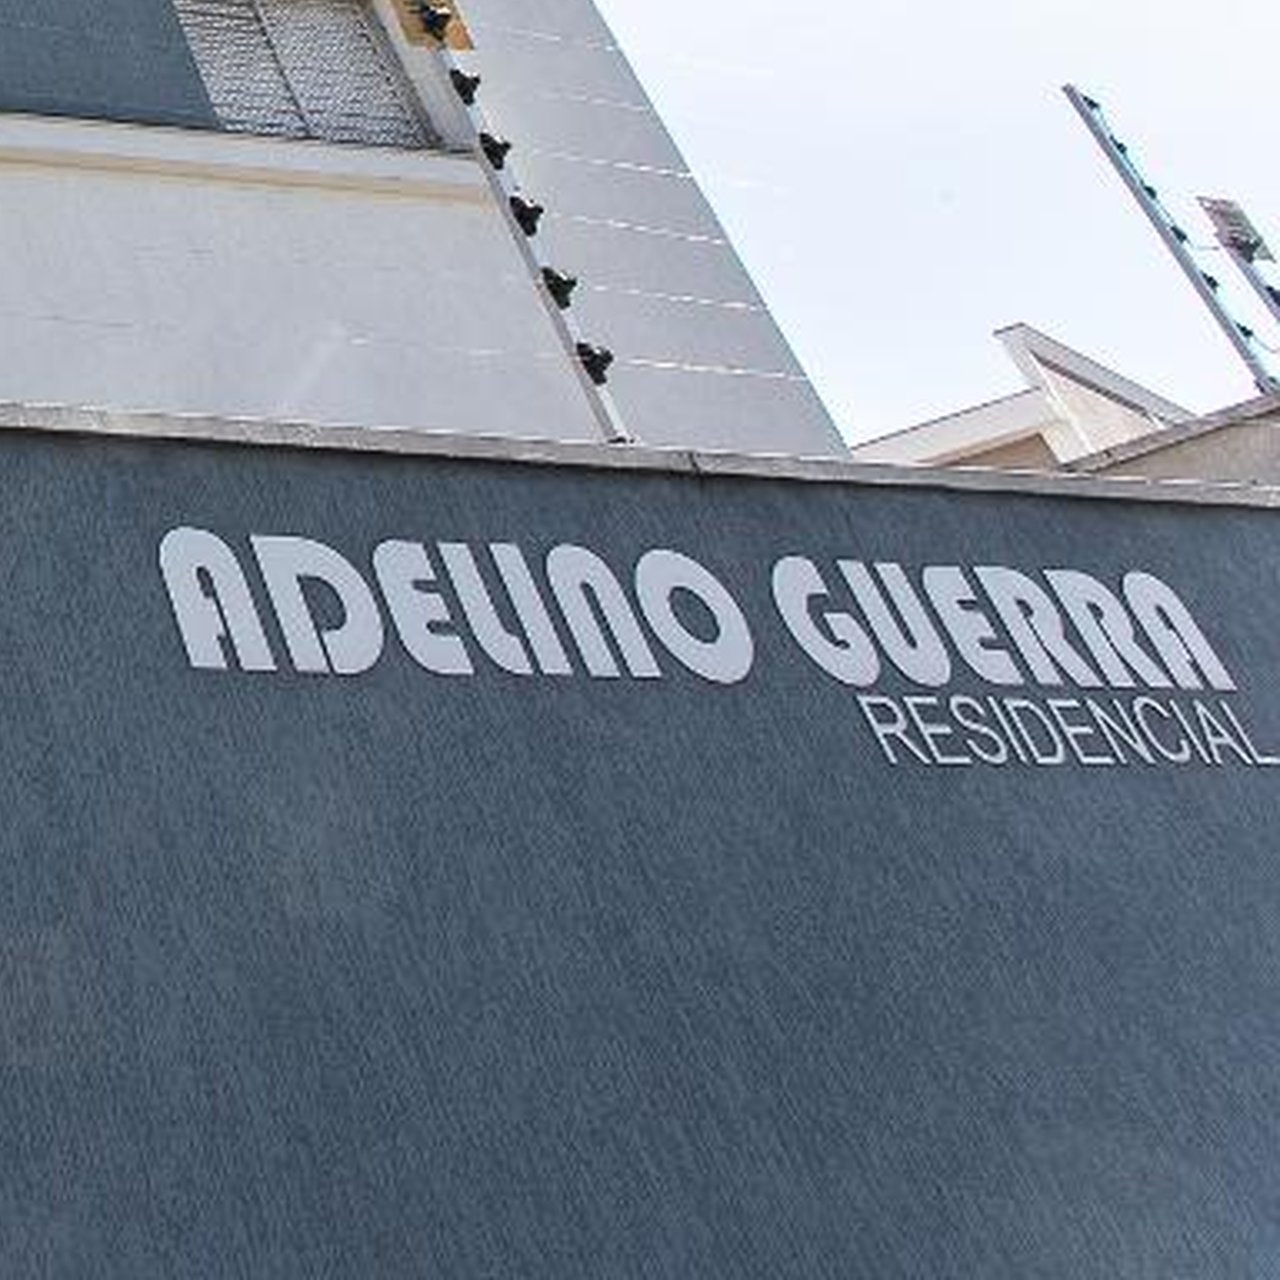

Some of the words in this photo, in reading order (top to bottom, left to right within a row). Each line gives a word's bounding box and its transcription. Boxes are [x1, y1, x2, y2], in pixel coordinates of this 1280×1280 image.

[158, 526, 755, 683] ADELINO
[771, 555, 1238, 691] GUERRA
[856, 695, 1280, 765] RESIDENCIAL
